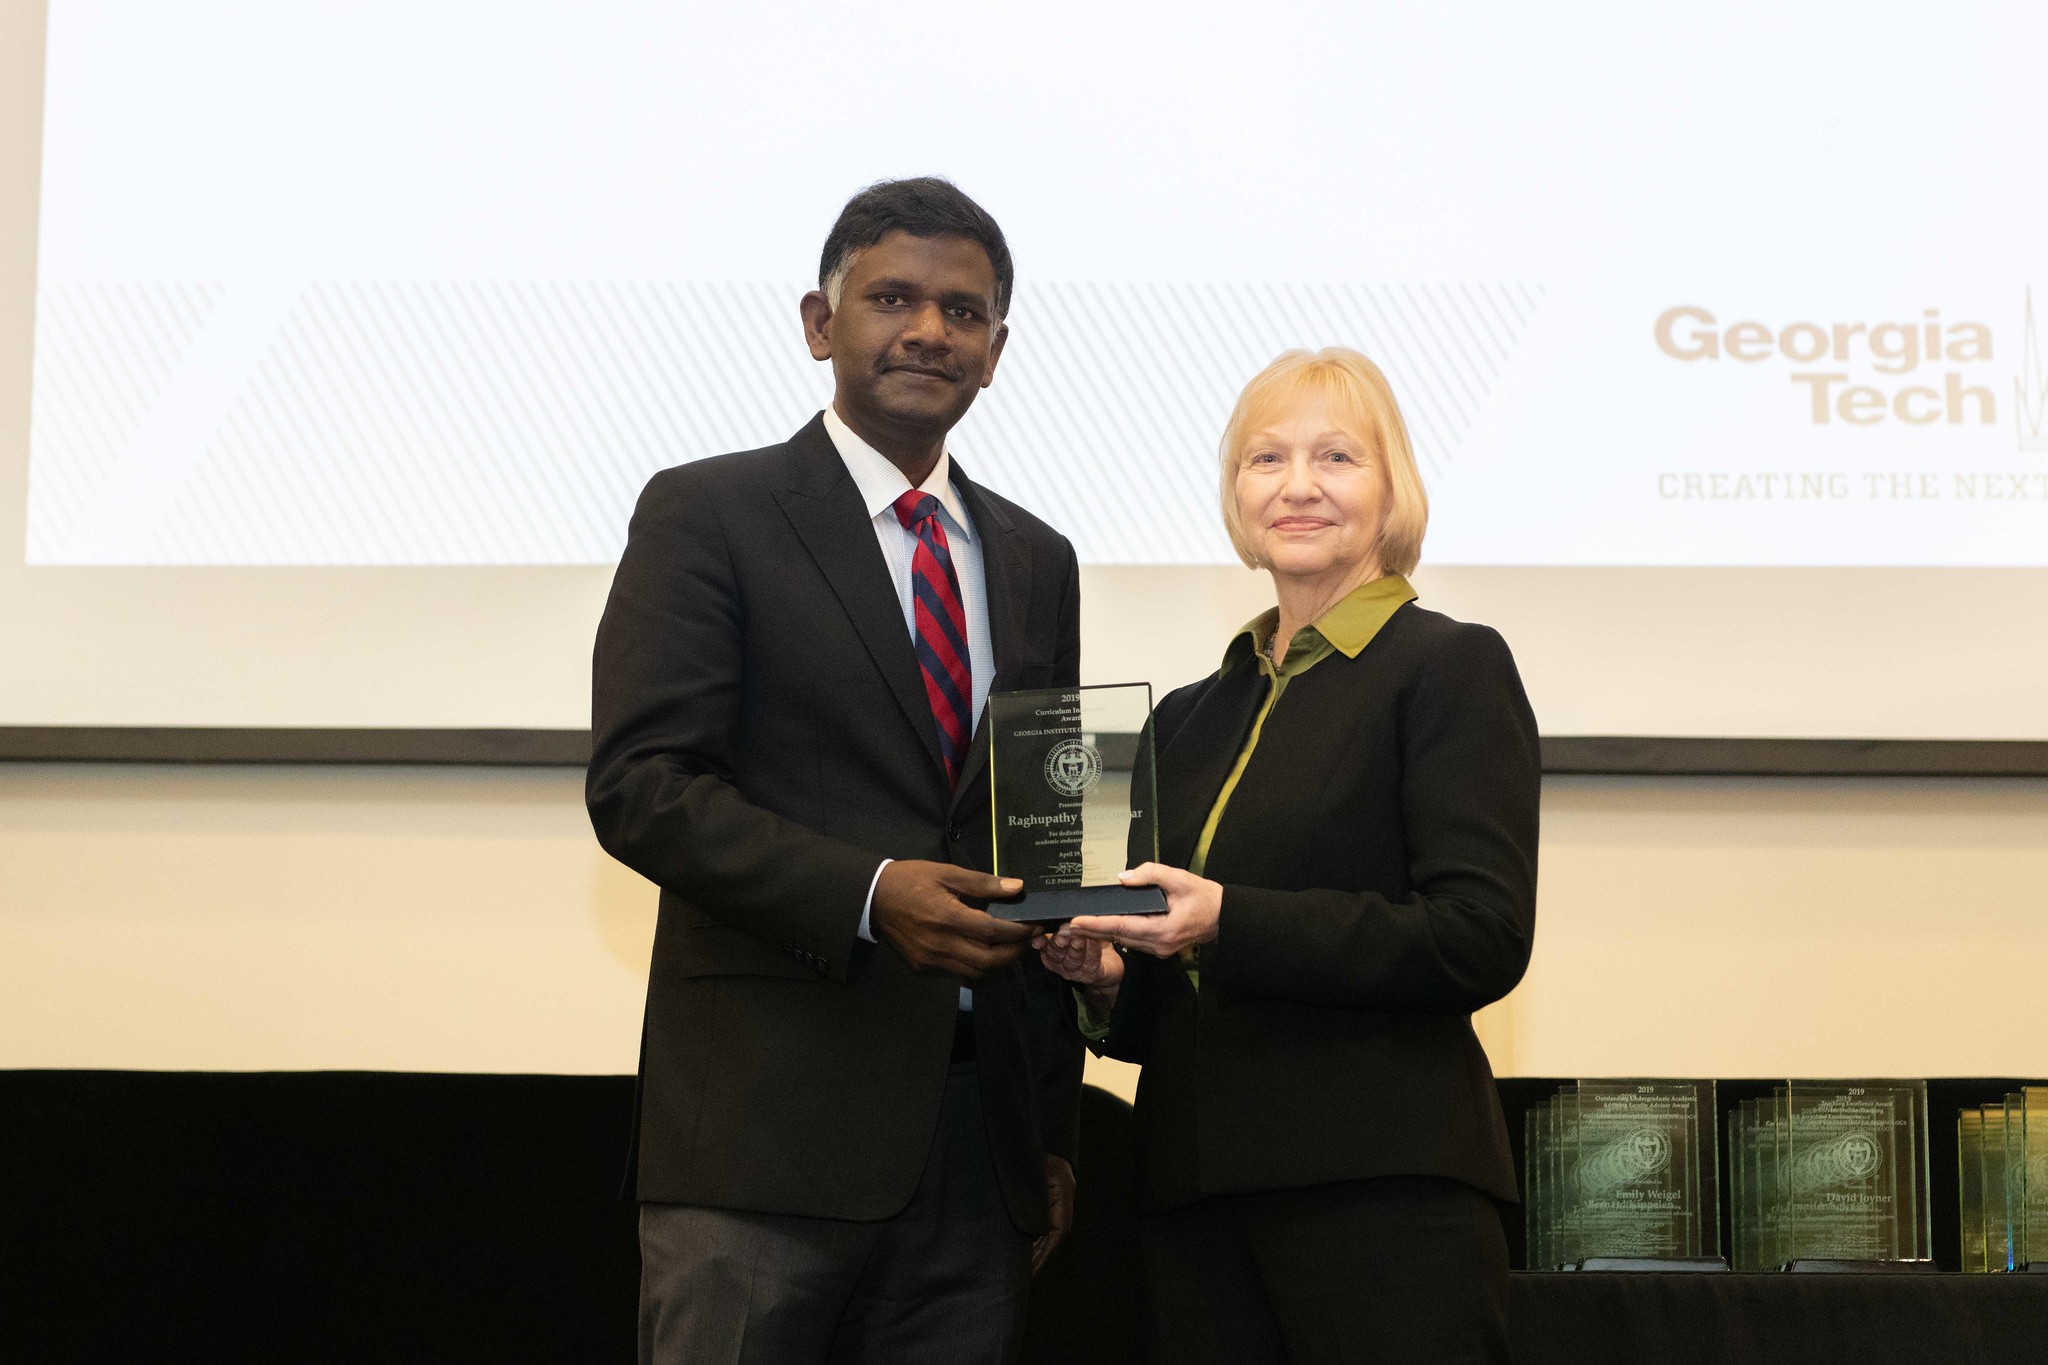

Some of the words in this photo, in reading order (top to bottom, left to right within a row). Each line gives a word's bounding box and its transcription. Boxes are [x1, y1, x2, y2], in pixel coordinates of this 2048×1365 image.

[1654, 305, 1993, 374] Georgia
[1791, 372, 1996, 425] Tech
[1657, 472, 1849, 500] CREATING
[1863, 471, 1940, 500] THE
[1061, 694, 1081, 703] 2019
[1035, 707, 1071, 716] Curriculum
[1013, 729, 1043, 737] GEORGIA
[1043, 727, 1077, 736] INSTITUTE
[1008, 812, 1078, 828] Raghupathy
[1035, 838, 1060, 846] academic
[1058, 851, 1073, 859] April
[1638, 1085, 1654, 1094] 2019
[1848, 1088, 1865, 1096] 2019
[1616, 1189, 1645, 1201] Emily
[1648, 1189, 1681, 1201] Weigel
[1826, 1193, 1857, 1202] David
[1860, 1193, 1892, 1204] Joyner
